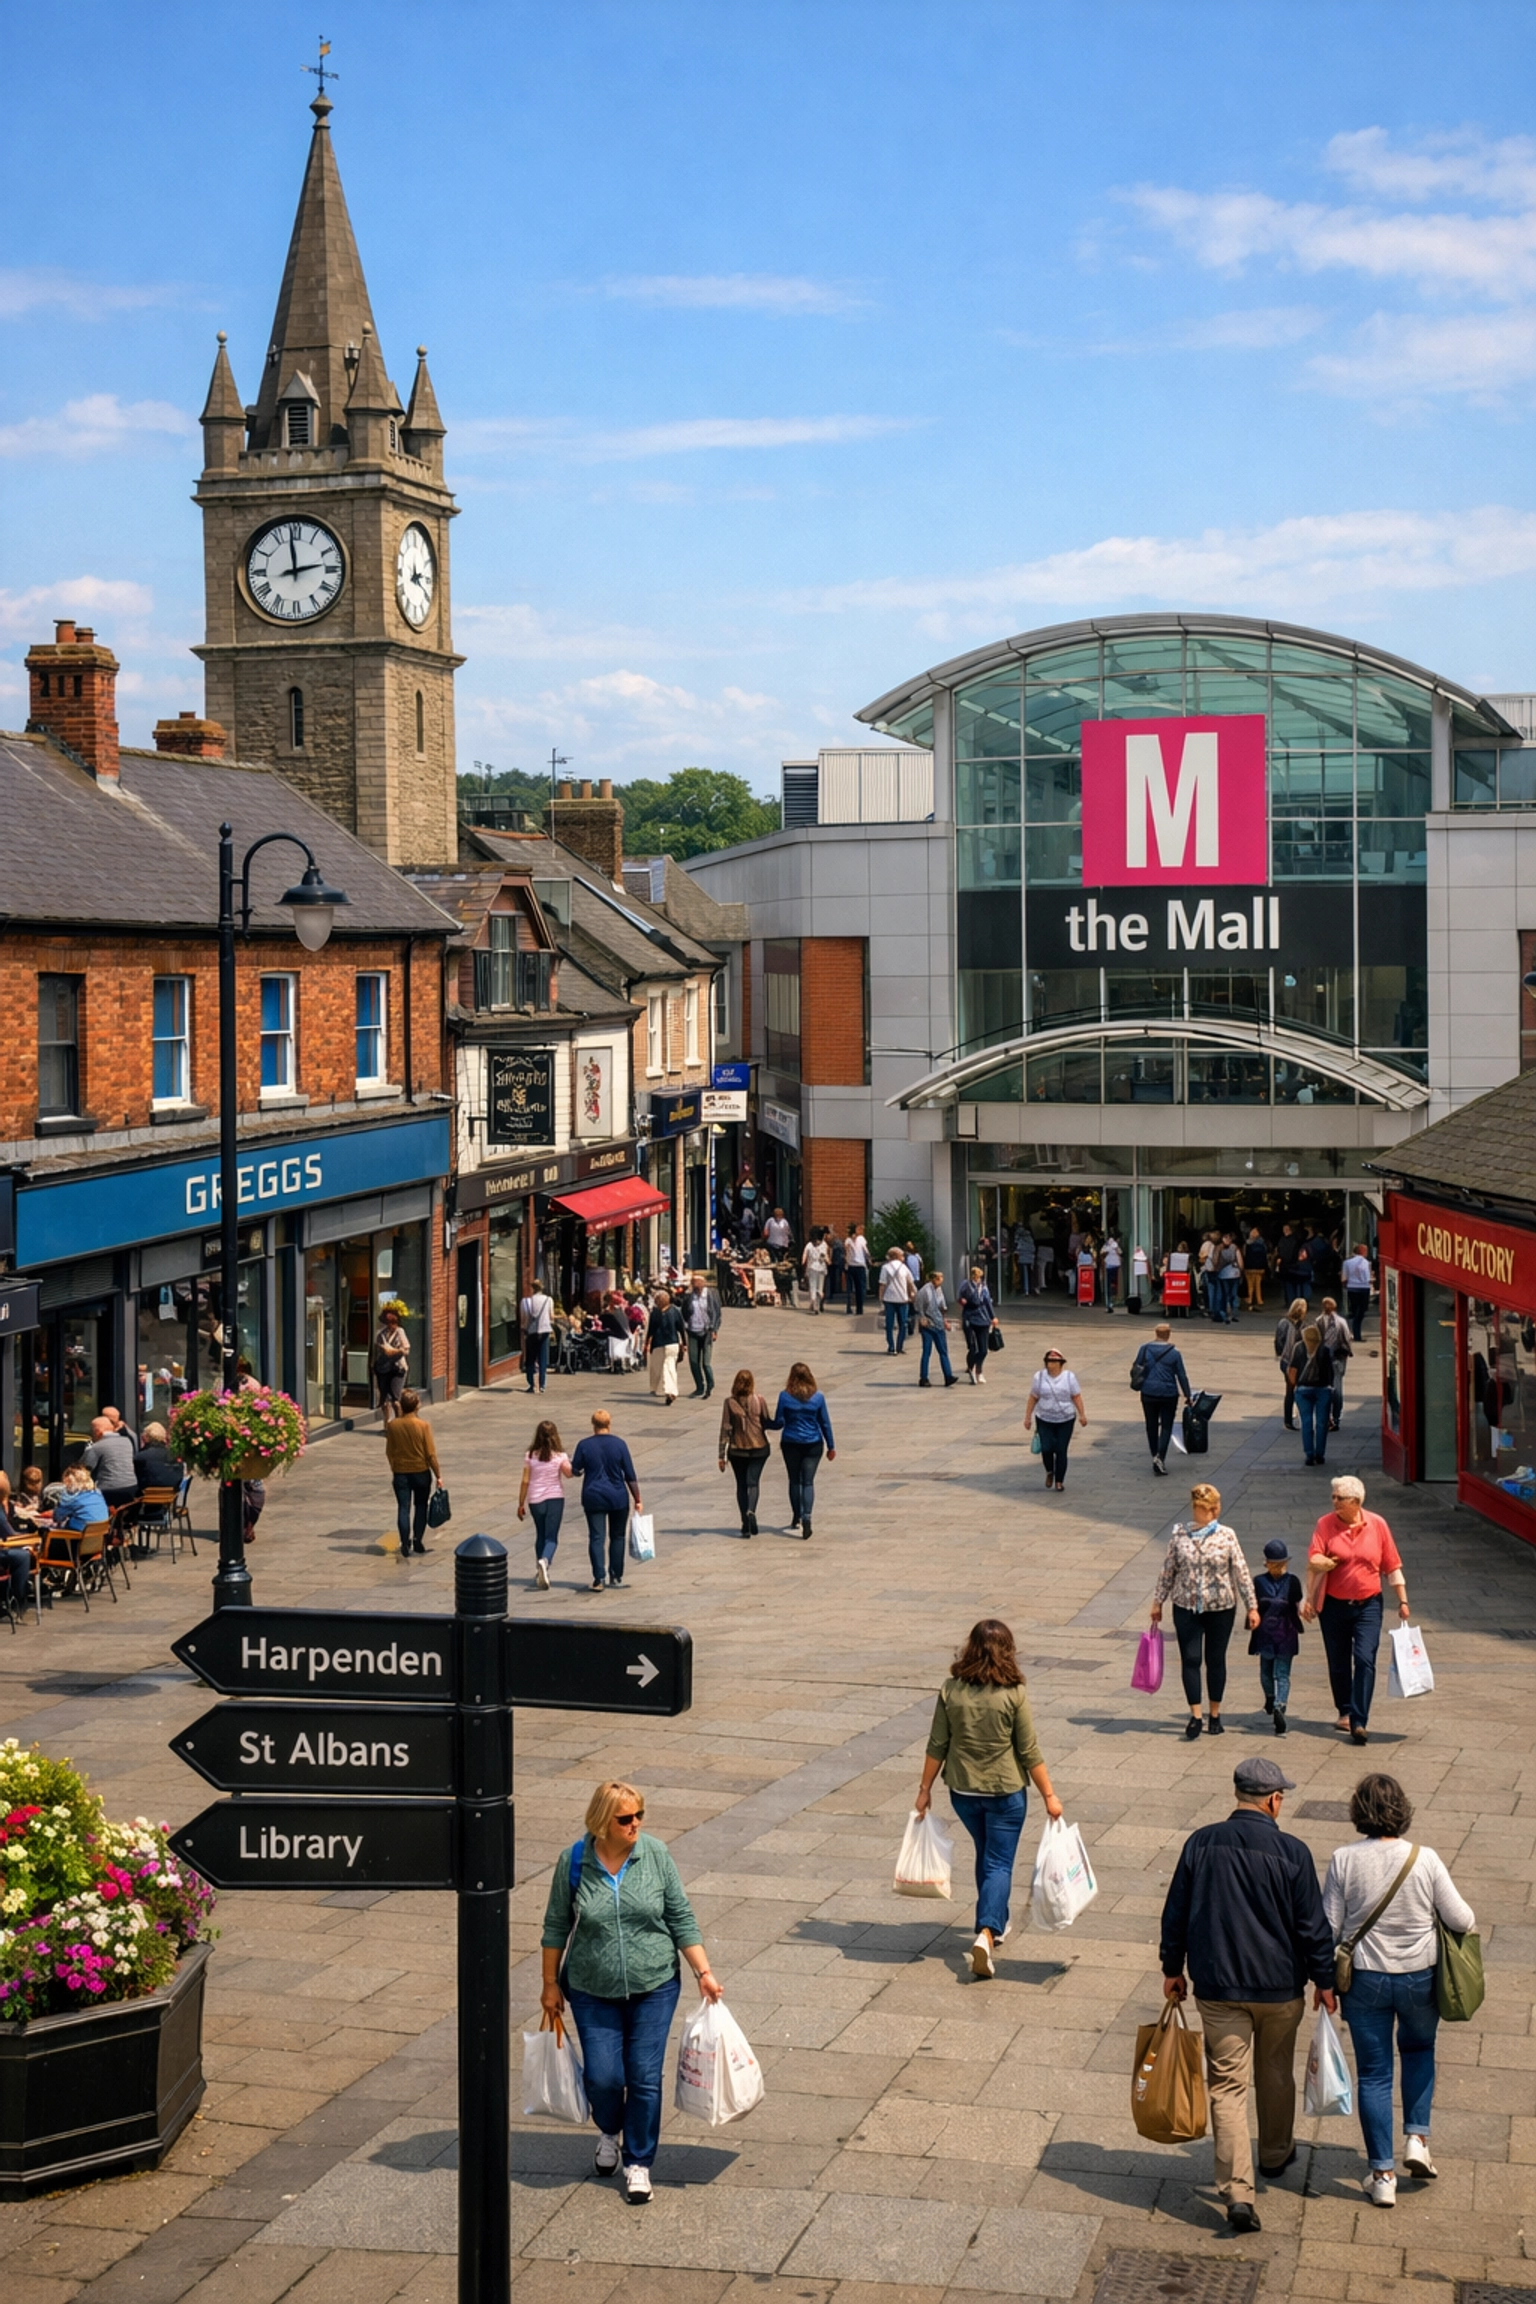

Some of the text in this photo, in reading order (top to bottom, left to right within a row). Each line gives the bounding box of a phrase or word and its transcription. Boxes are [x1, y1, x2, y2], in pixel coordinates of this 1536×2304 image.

[1125, 732, 1219, 868] M
[1065, 896, 1279, 952] the Mall
[1417, 1222, 1515, 1286] CARD FACTORY
[241, 1636, 442, 1682] Harpenden
[239, 1730, 410, 1767] St Albans
[239, 1825, 364, 1867] Library
